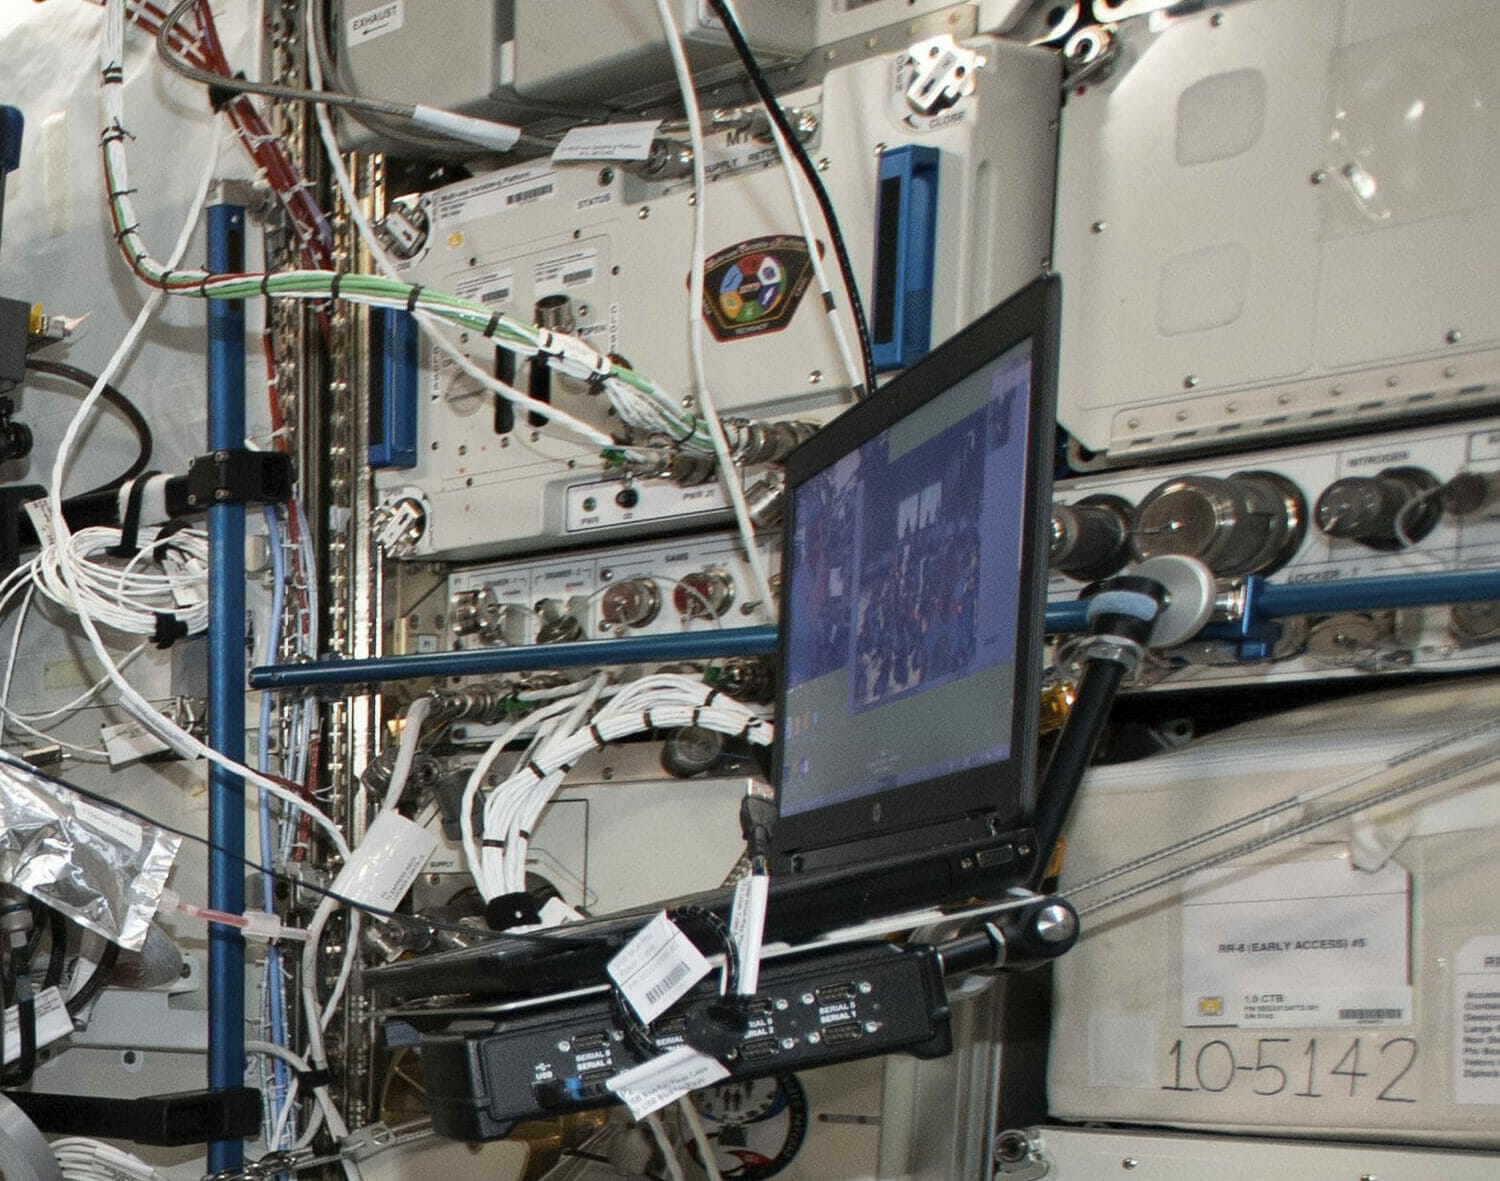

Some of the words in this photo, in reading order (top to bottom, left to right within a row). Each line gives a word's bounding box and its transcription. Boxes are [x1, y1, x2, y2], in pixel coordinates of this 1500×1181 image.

[353, 4, 398, 31] EXHAUST
[1247, 941, 1292, 953] (EARLY
[1294, 938, 1349, 950] ACCESS)
[535, 1071, 554, 1081] USB
[1161, 1037, 1419, 1103] 10-5142
